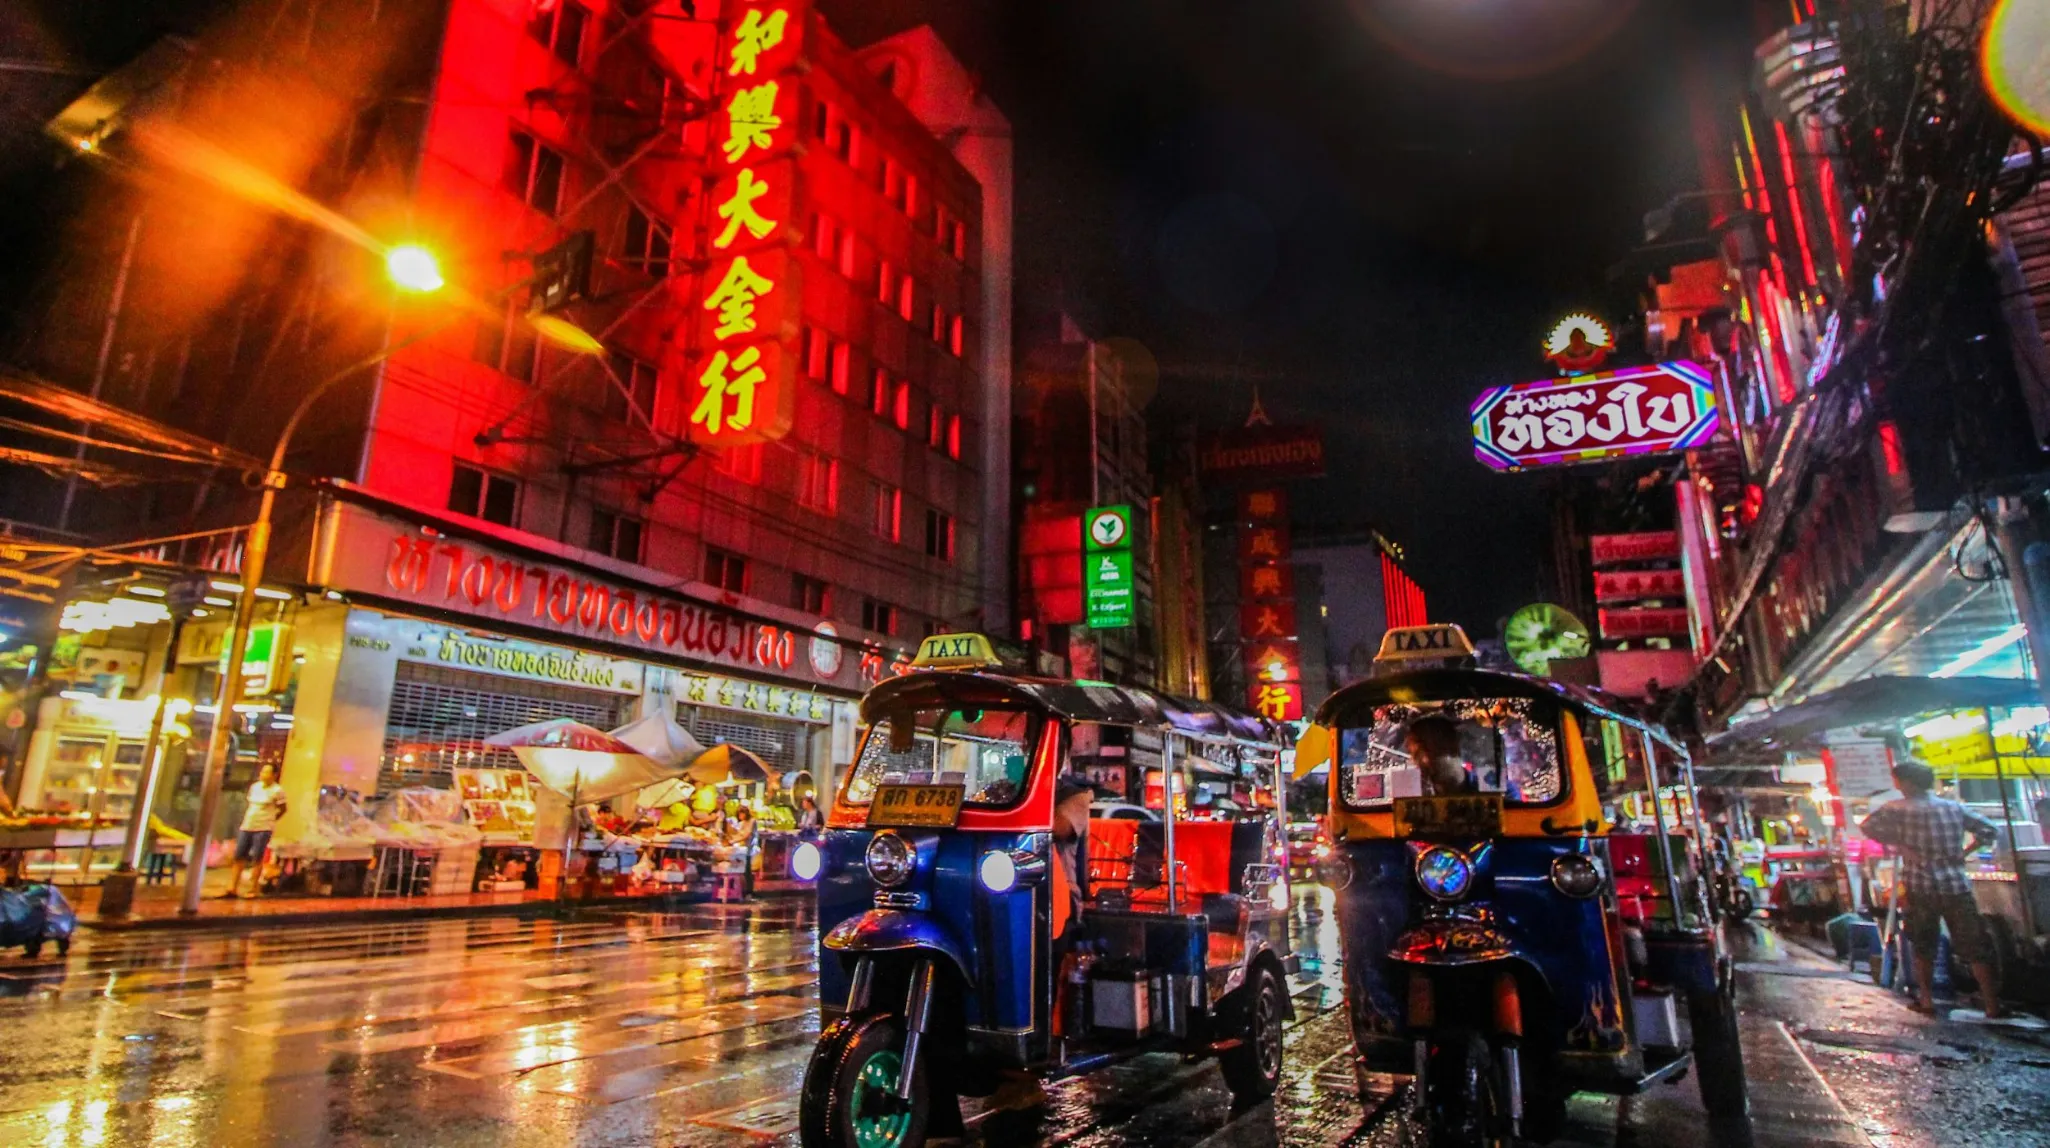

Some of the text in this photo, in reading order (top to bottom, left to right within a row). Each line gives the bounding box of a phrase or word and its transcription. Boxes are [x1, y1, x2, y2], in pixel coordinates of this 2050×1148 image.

[926, 637, 973, 659] TAXI
[1393, 629, 1454, 651] TAXI
[914, 788, 957, 807] 6738
